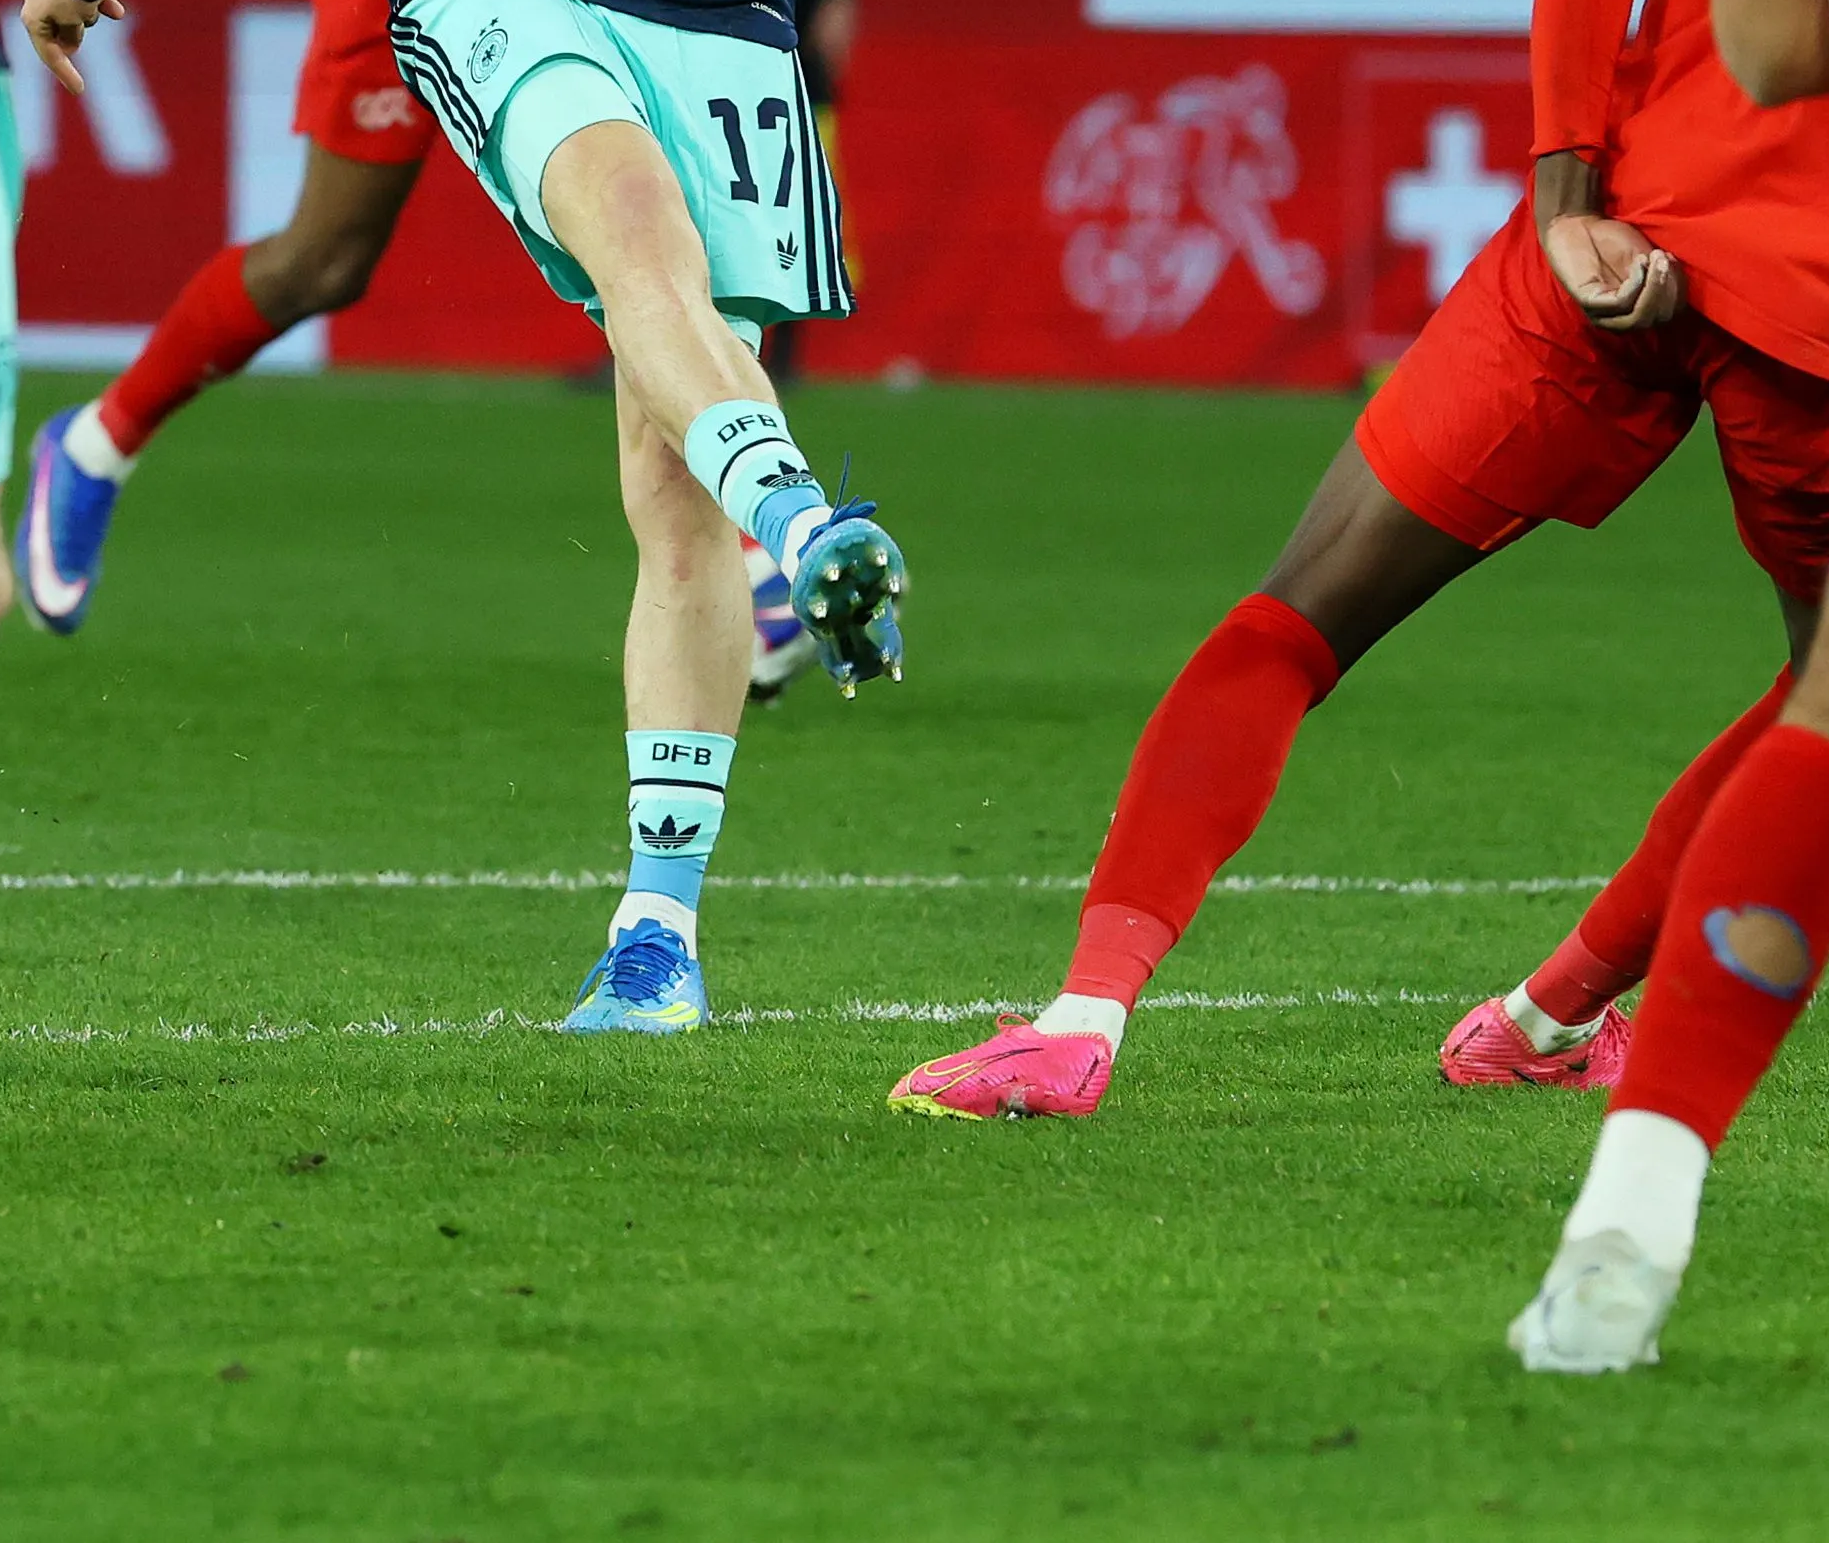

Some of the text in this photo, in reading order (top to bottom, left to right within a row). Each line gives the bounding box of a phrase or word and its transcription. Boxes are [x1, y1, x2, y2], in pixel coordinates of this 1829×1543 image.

[708, 97, 794, 208] 17
[717, 414, 777, 444] DFB
[652, 743, 712, 765] DFB
